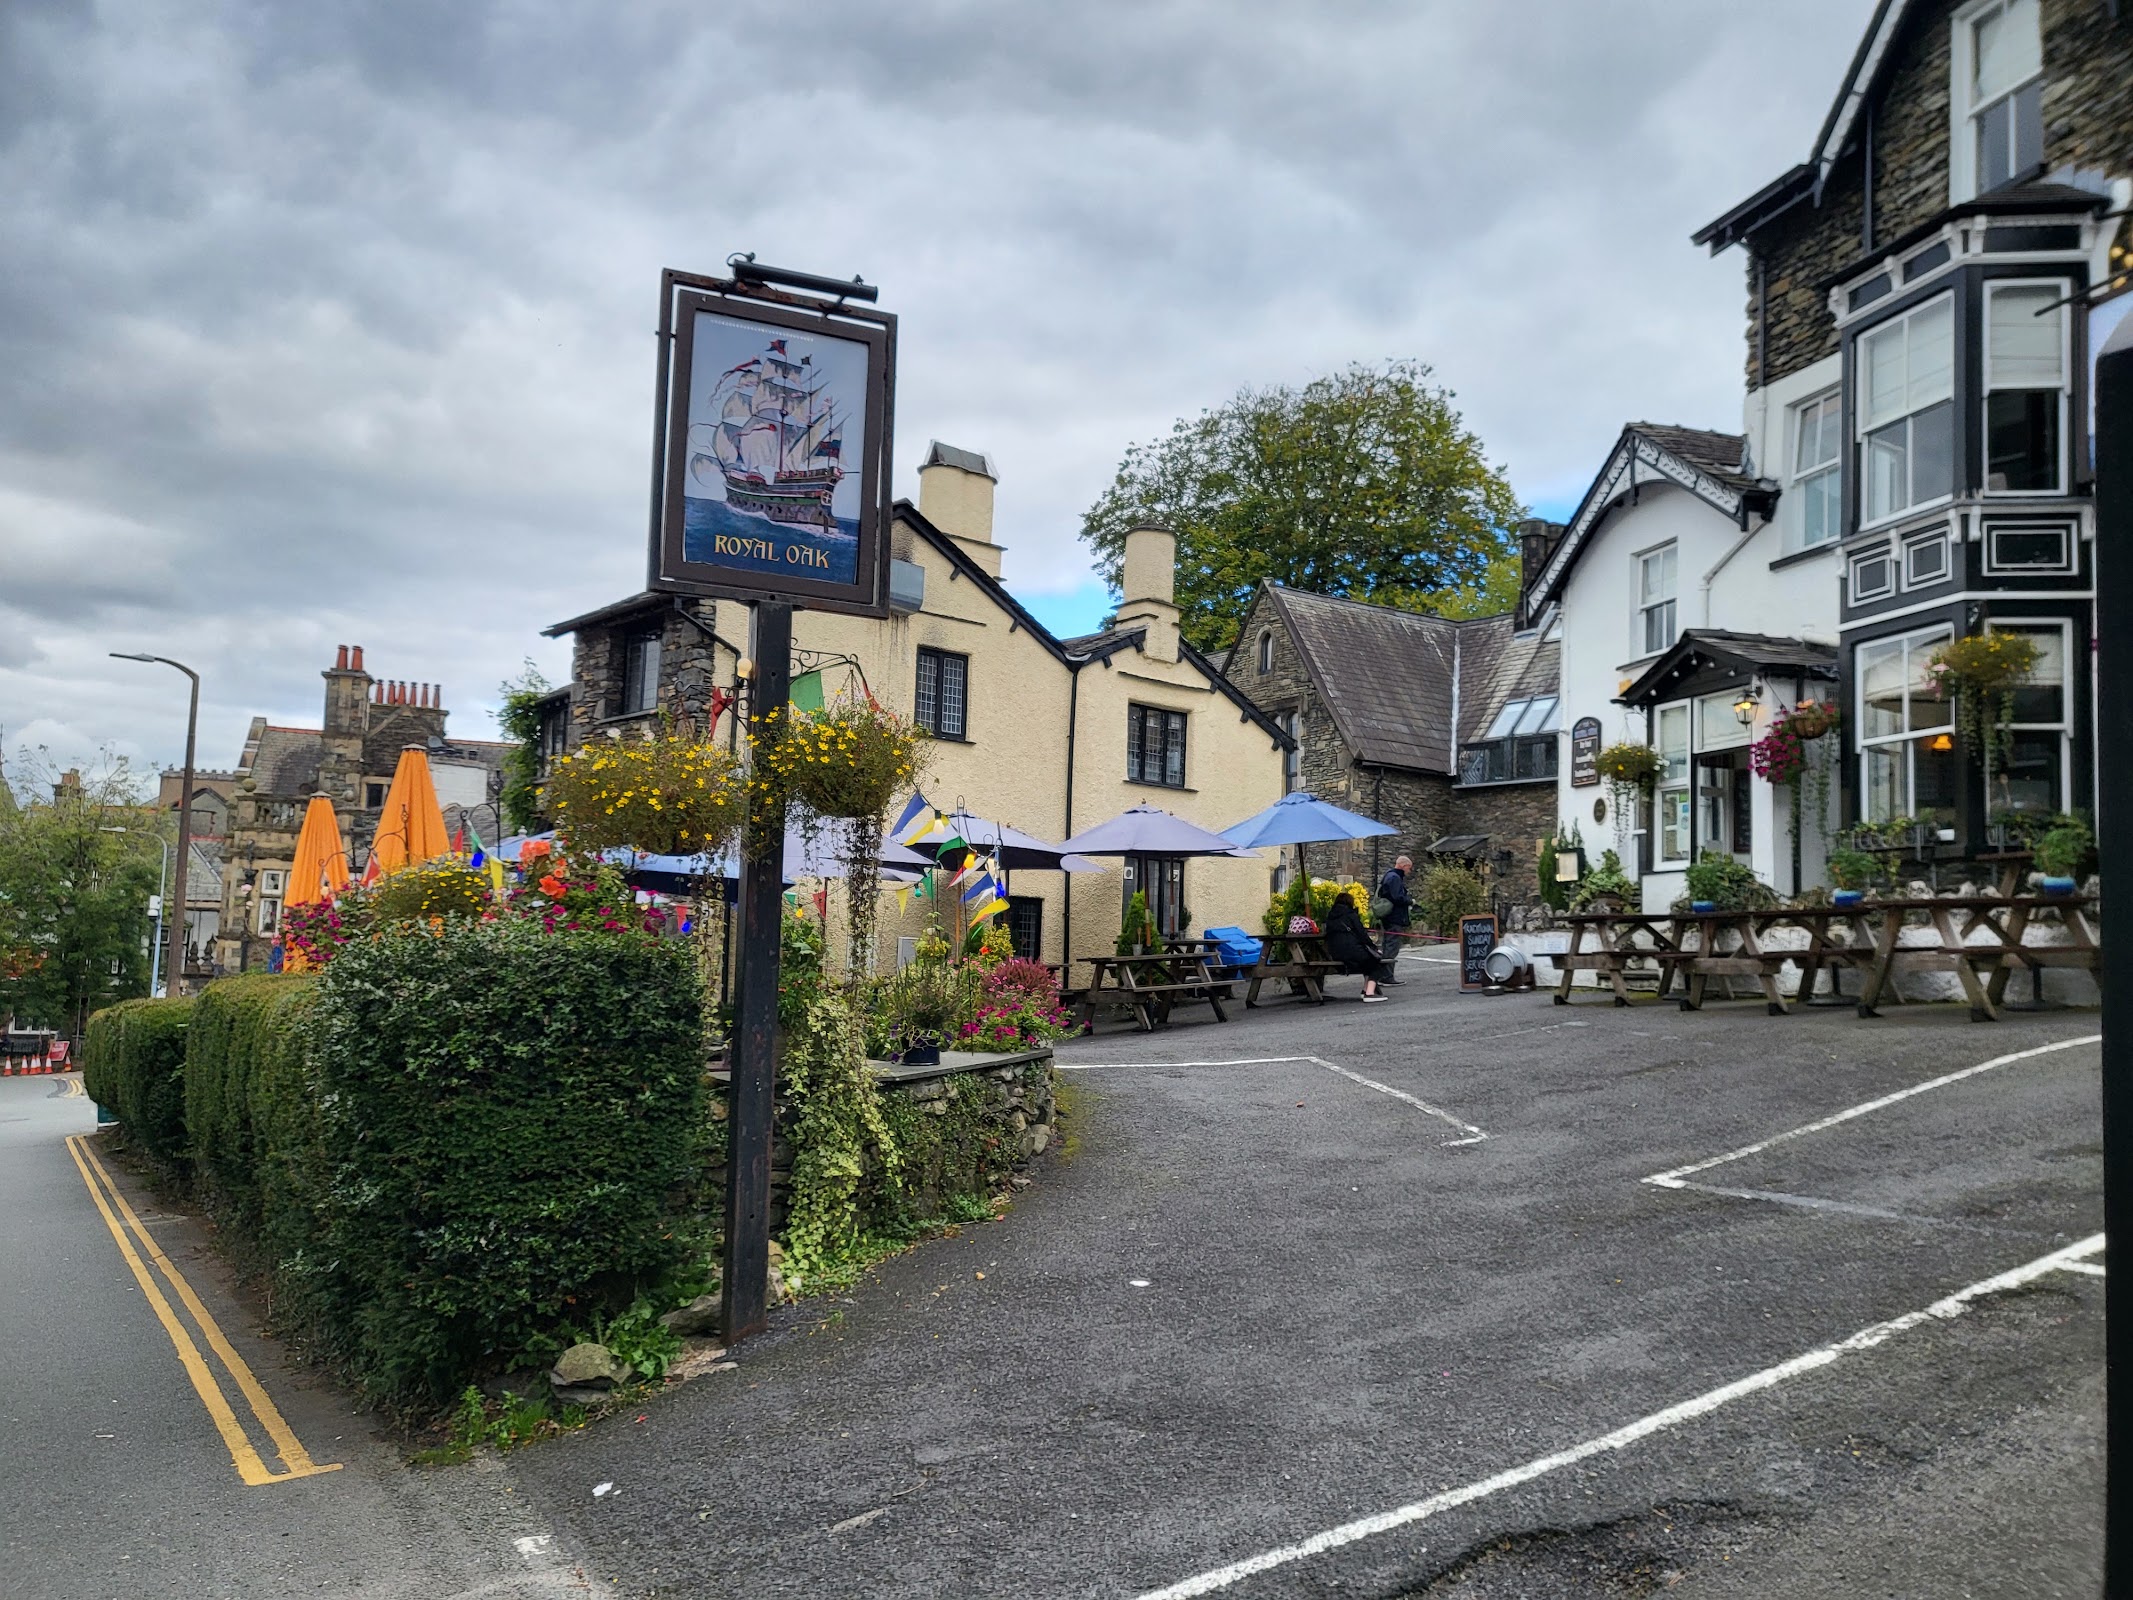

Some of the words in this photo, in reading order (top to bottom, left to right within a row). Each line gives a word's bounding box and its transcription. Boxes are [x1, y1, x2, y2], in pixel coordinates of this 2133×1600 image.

[714, 534, 780, 562] ROYAL
[785, 544, 830, 569] OAK
[1468, 934, 1491, 946] SUNDAY
[1468, 944, 1489, 959] ROAST
[1465, 959, 1486, 971] SERVE
[1469, 970, 1481, 982] HE
